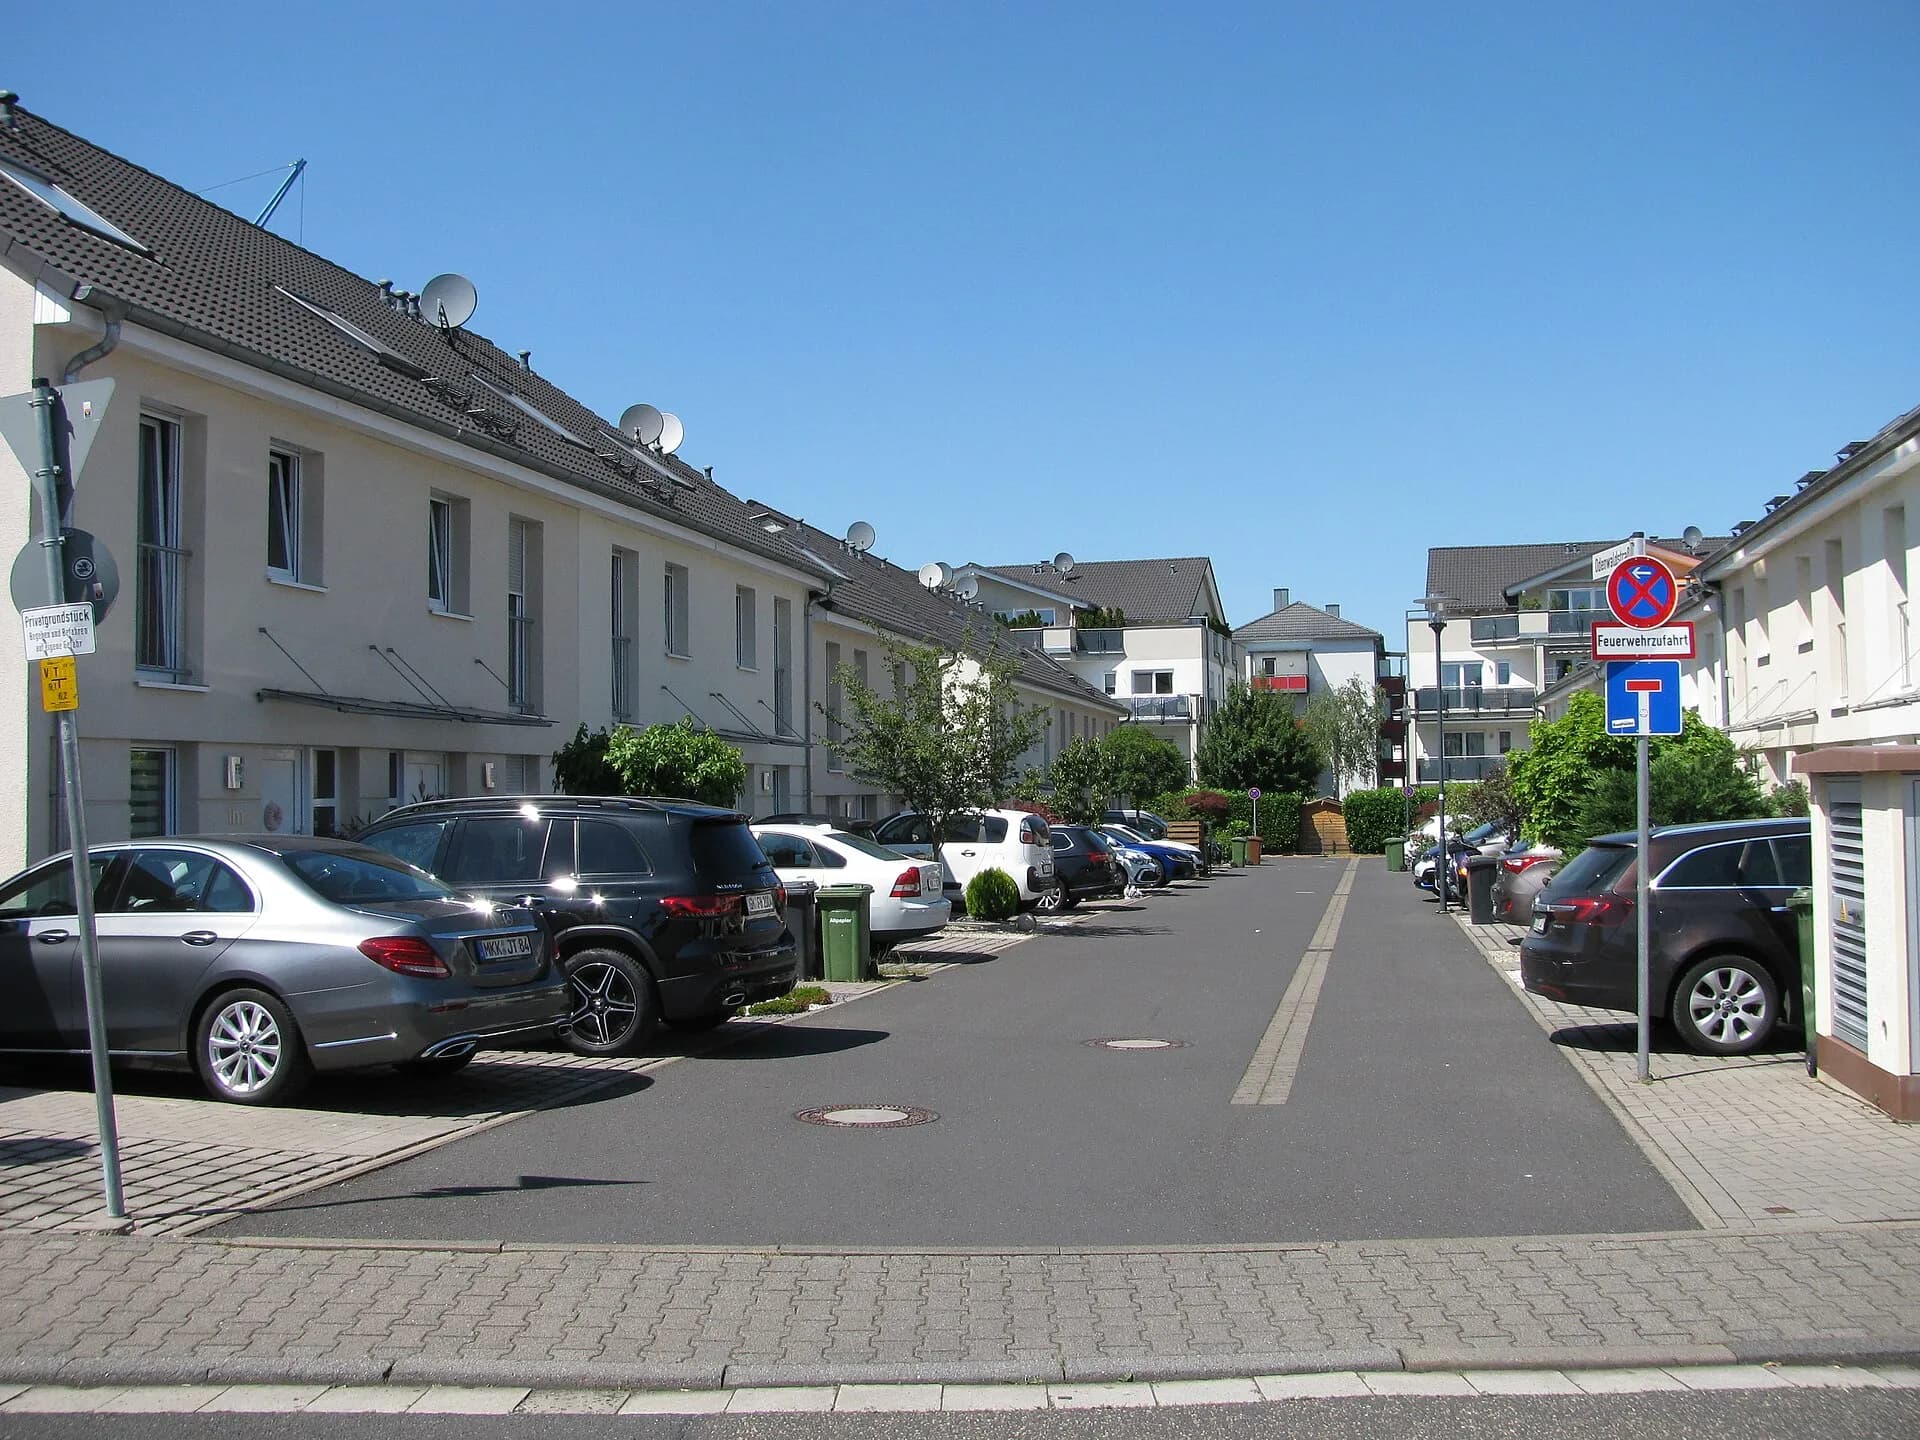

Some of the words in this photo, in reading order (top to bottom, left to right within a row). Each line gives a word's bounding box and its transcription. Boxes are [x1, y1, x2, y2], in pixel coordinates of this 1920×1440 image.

[25, 608, 90, 628] Privatgrundstück
[51, 629, 61, 638] und
[62, 627, 88, 637] Befahren
[1598, 634, 1689, 647] Feuerwehrzufahrt
